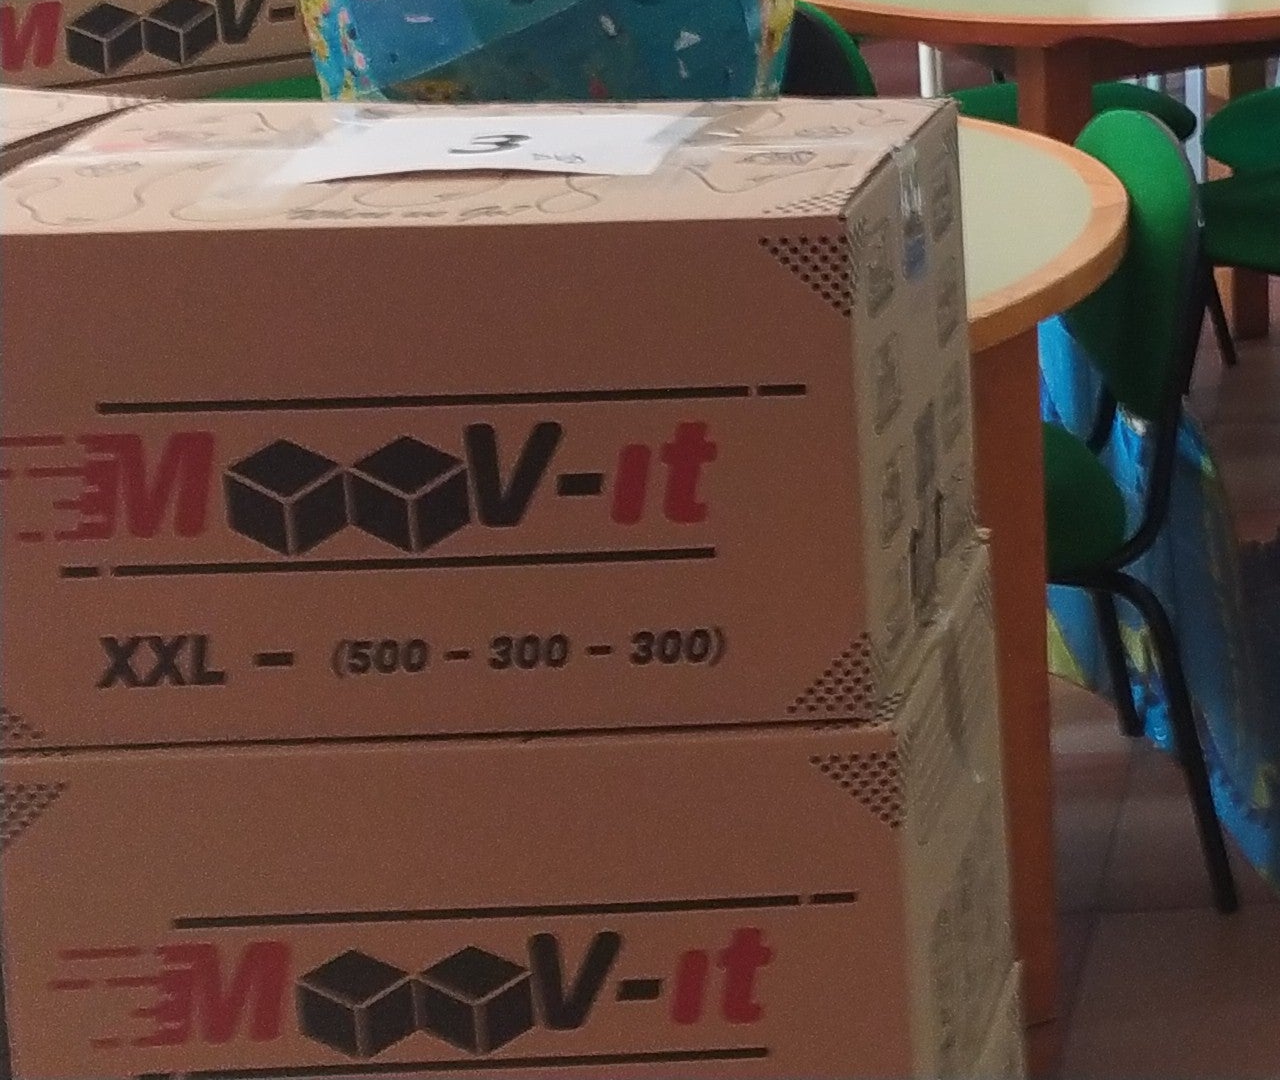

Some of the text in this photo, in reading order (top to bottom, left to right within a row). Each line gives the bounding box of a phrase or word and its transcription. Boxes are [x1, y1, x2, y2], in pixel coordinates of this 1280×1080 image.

[448, 133, 531, 154] 3
[95, 635, 227, 689] XXL
[331, 638, 430, 678] (500
[489, 633, 570, 671] 300
[629, 626, 728, 669] 300)
